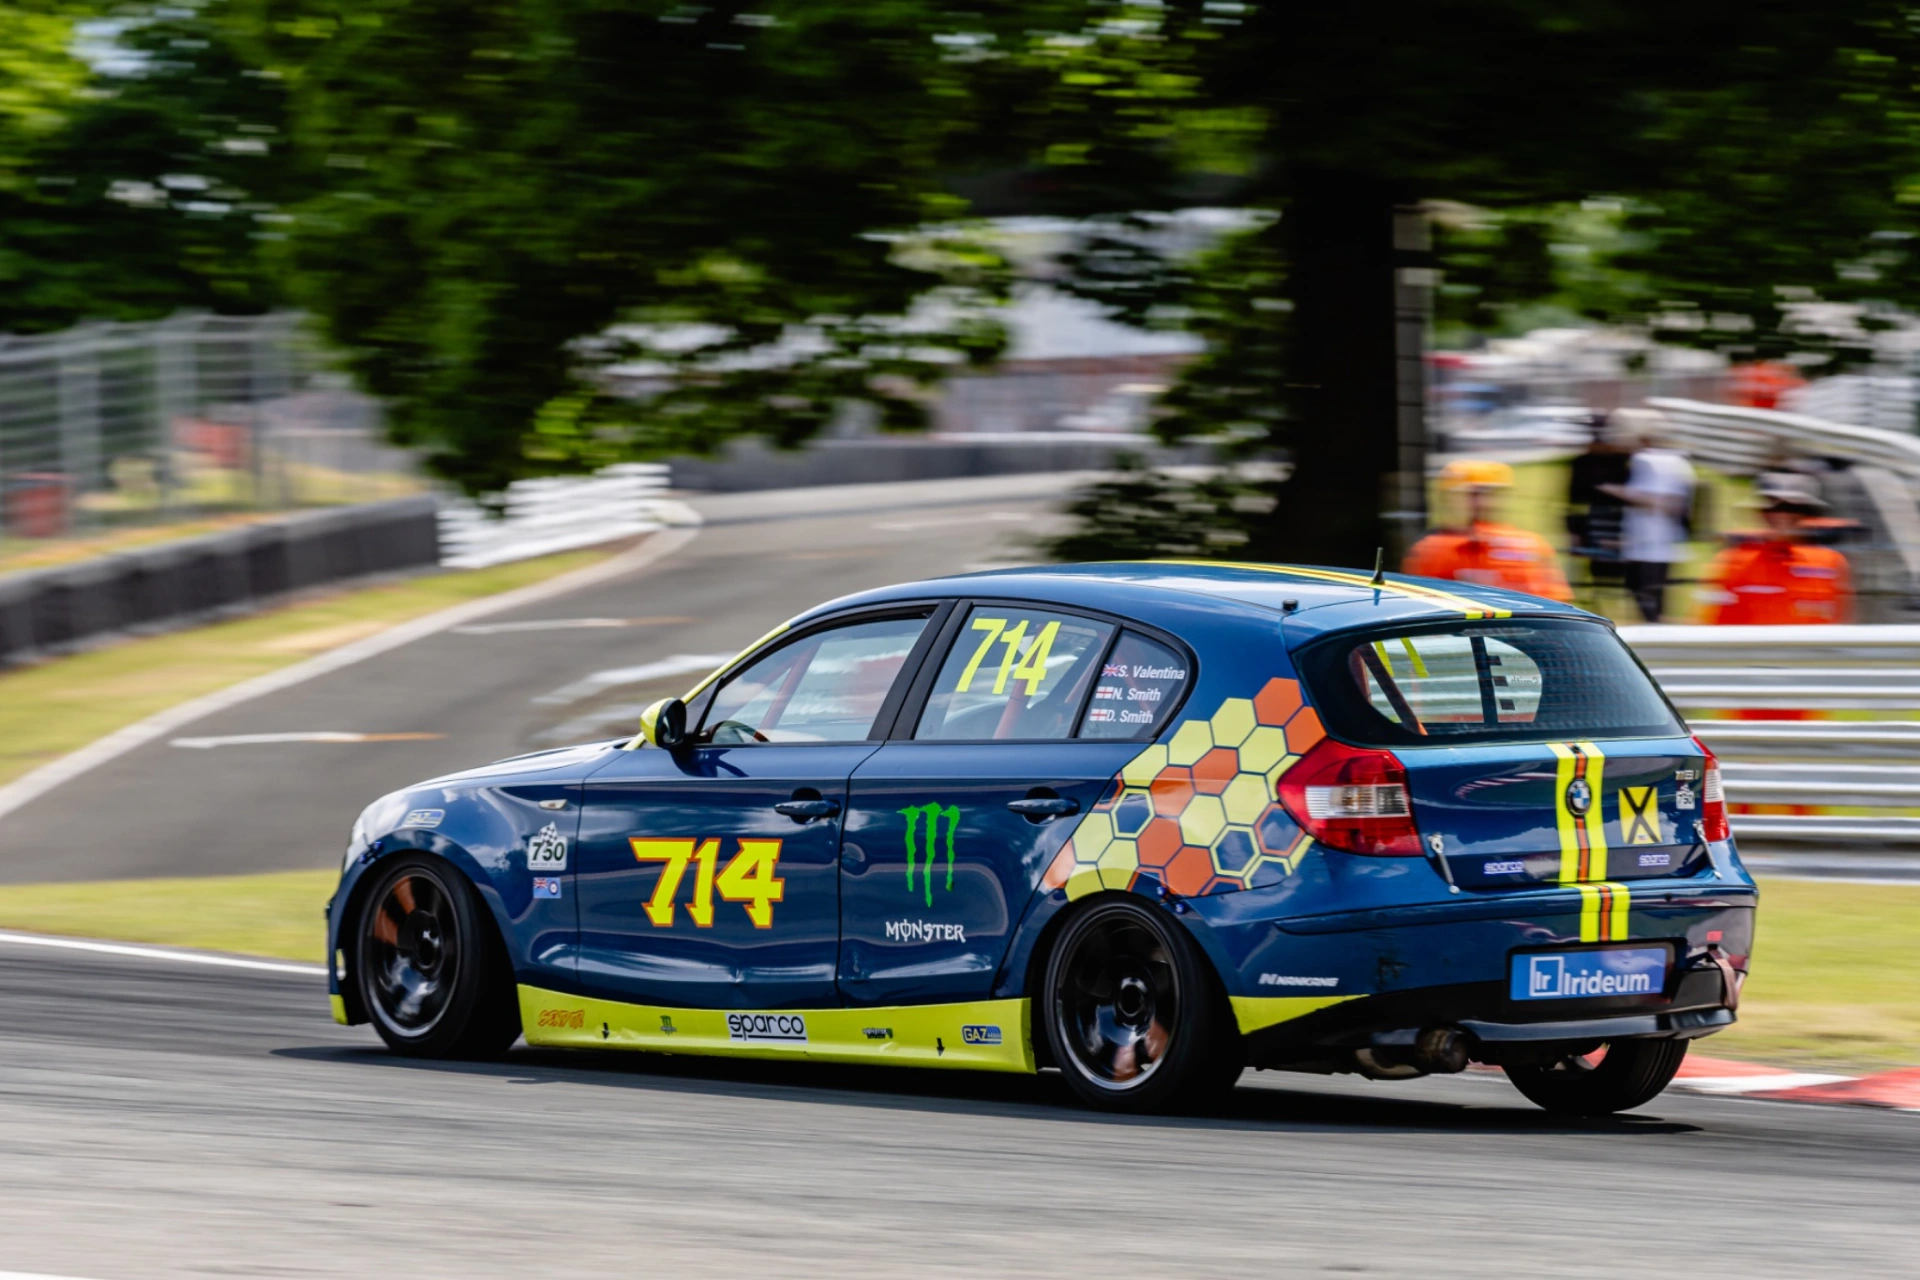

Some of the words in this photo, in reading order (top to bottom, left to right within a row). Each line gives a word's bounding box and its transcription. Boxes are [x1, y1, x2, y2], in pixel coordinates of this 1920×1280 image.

[955, 618, 1061, 696] 714
[1118, 664, 1129, 677] S.
[1132, 665, 1185, 679] Valentina
[1112, 687, 1123, 700] N.
[1127, 688, 1161, 701] Smith
[1106, 709, 1116, 722] D.
[1120, 710, 1153, 723] Smith
[532, 841, 565, 861] 750
[1639, 854, 1671, 865] sparco
[1484, 862, 1524, 873] sparco
[628, 837, 785, 929] 714
[885, 919, 966, 943] MONSTER
[1563, 969, 1650, 995] Irideum
[728, 1014, 804, 1041] sparco
[963, 1027, 987, 1042] GAZ
